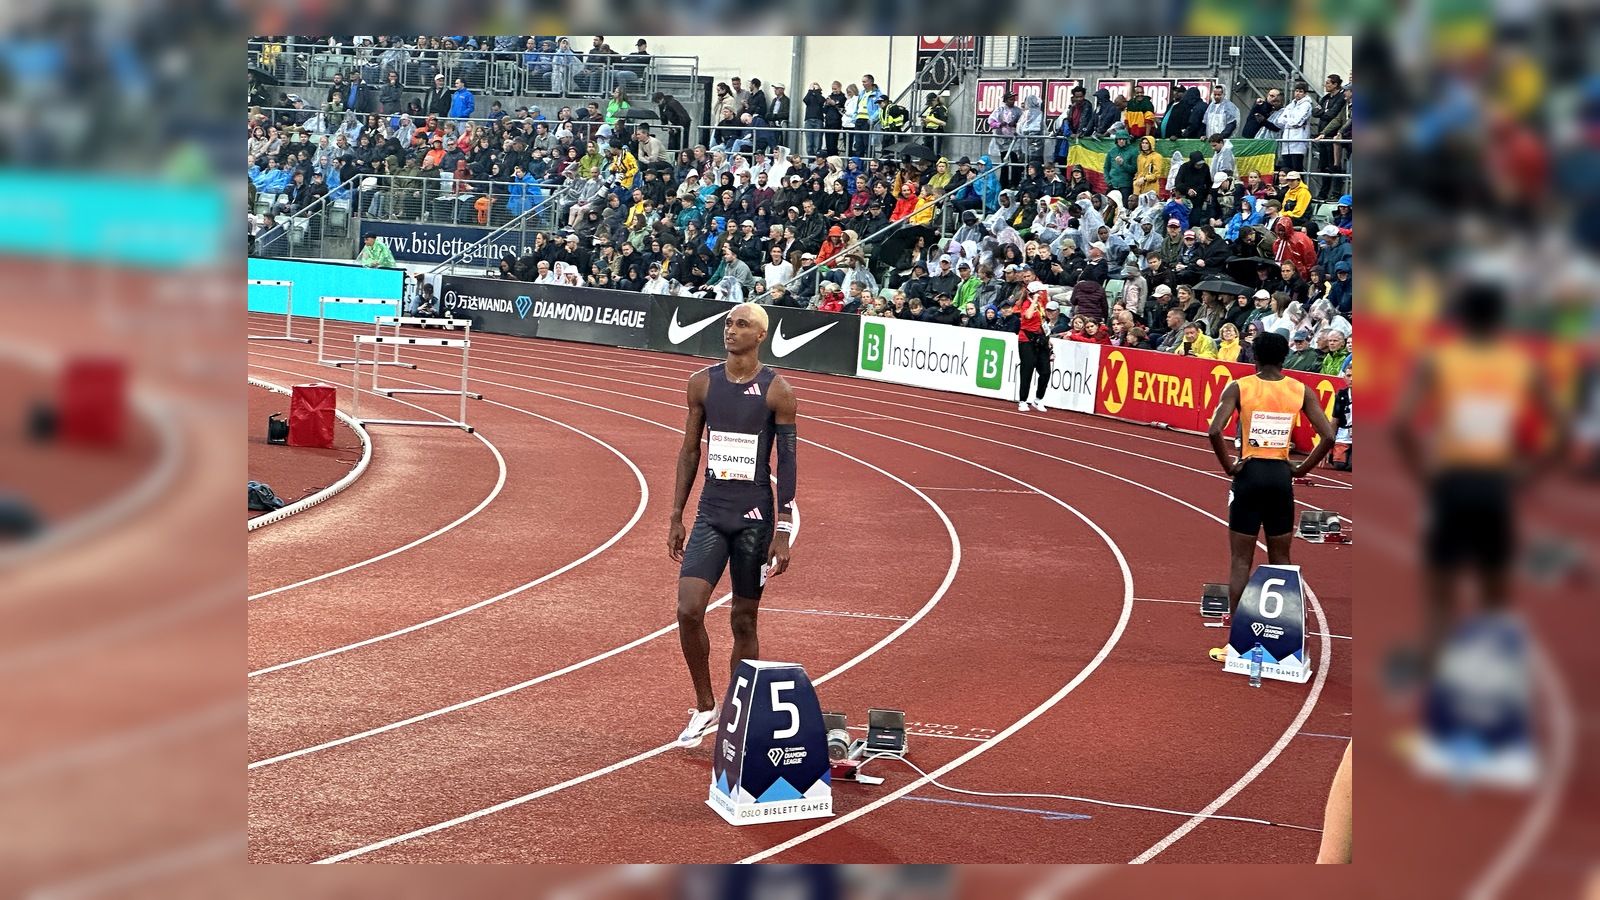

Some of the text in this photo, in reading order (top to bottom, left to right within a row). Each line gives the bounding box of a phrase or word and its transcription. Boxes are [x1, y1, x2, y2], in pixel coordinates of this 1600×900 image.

[533, 301, 593, 322] DIAMOND
[595, 307, 646, 328] LEAGUE
[888, 334, 969, 377] Instabank
[1133, 370, 1194, 409] EXTRA
[724, 436, 755, 444] Storebrand
[1252, 428, 1289, 436] MCMASTER
[723, 455, 755, 464] SANTOS
[1259, 578, 1286, 619] 6
[1276, 668, 1299, 677] GAMES
[727, 676, 749, 734] 5
[770, 681, 800, 739] 5
[741, 803, 829, 818] OSLO BISLETT GAMES
